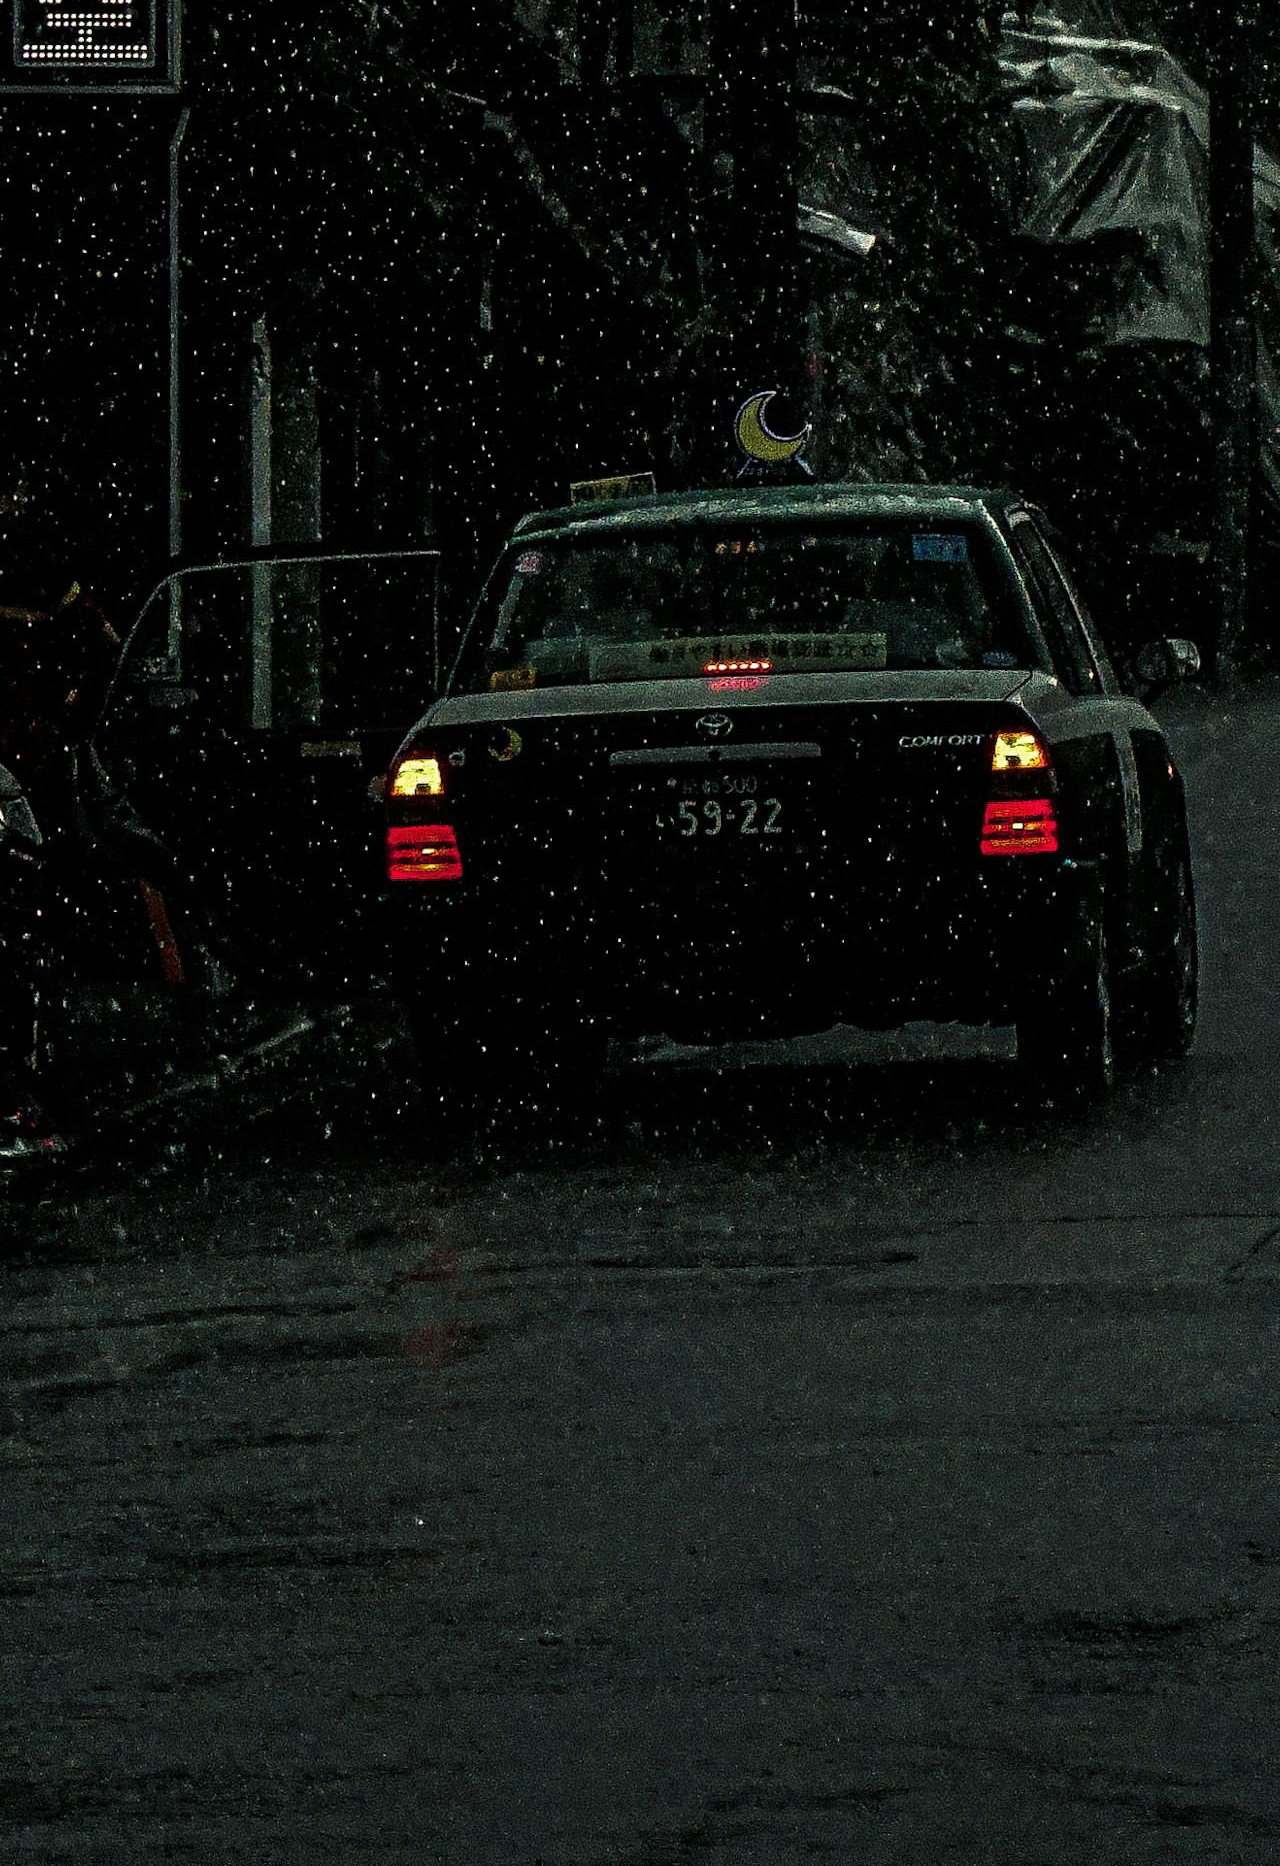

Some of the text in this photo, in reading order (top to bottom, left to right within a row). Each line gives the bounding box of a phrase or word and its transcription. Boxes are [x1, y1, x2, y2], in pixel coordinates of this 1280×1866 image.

[898, 734, 983, 748] COMFORT
[721, 774, 759, 795] 500
[677, 797, 784, 837] 59-22
